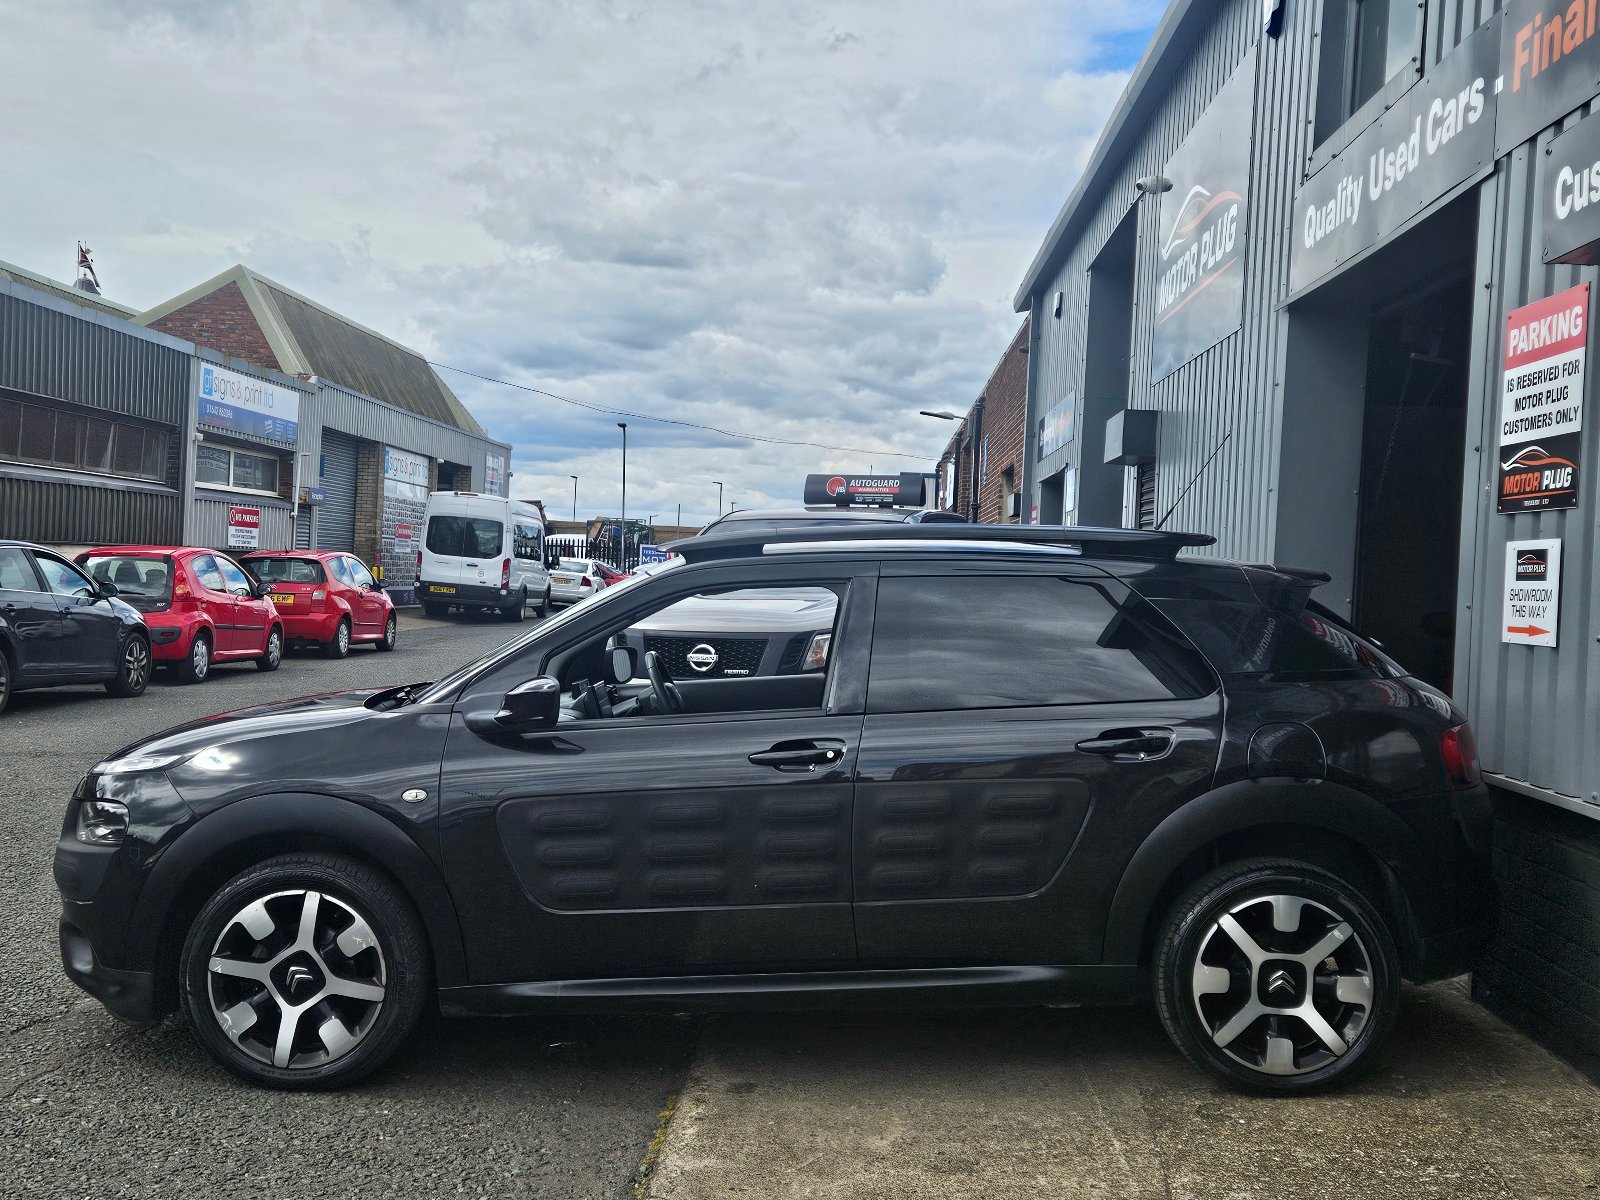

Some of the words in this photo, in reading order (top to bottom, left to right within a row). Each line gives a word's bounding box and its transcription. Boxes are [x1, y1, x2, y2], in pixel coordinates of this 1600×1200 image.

[1304, 174, 1364, 248] Quality
[1369, 115, 1422, 201] Used
[1426, 77, 1485, 155] Cars
[1159, 242, 1198, 314] MOTOR
[1199, 203, 1238, 277] PLUG
[1508, 305, 1583, 357] PARKING
[1507, 379, 1515, 394] IS
[1516, 365, 1560, 391] RESERVED
[1562, 359, 1581, 378] FOR
[214, 376, 236, 400] signs
[244, 384, 262, 406] print
[263, 386, 274, 408] ltd
[1514, 393, 1543, 412] MOTOR
[1545, 385, 1569, 404] PLUG
[1503, 412, 1553, 436] CUSTOMERS
[1555, 405, 1580, 425] ONLY
[850, 479, 900, 488] AUTOGUARD
[1504, 471, 1541, 494] MOTOR
[1542, 467, 1573, 490] PLUG
[242, 514, 259, 523] PARKING
[1518, 565, 1533, 573] MOTOR
[1534, 564, 1546, 573] PLUG
[1509, 588, 1553, 603] SHOWROOM
[1512, 605, 1527, 618] THIS
[1528, 605, 1548, 619] WAY
